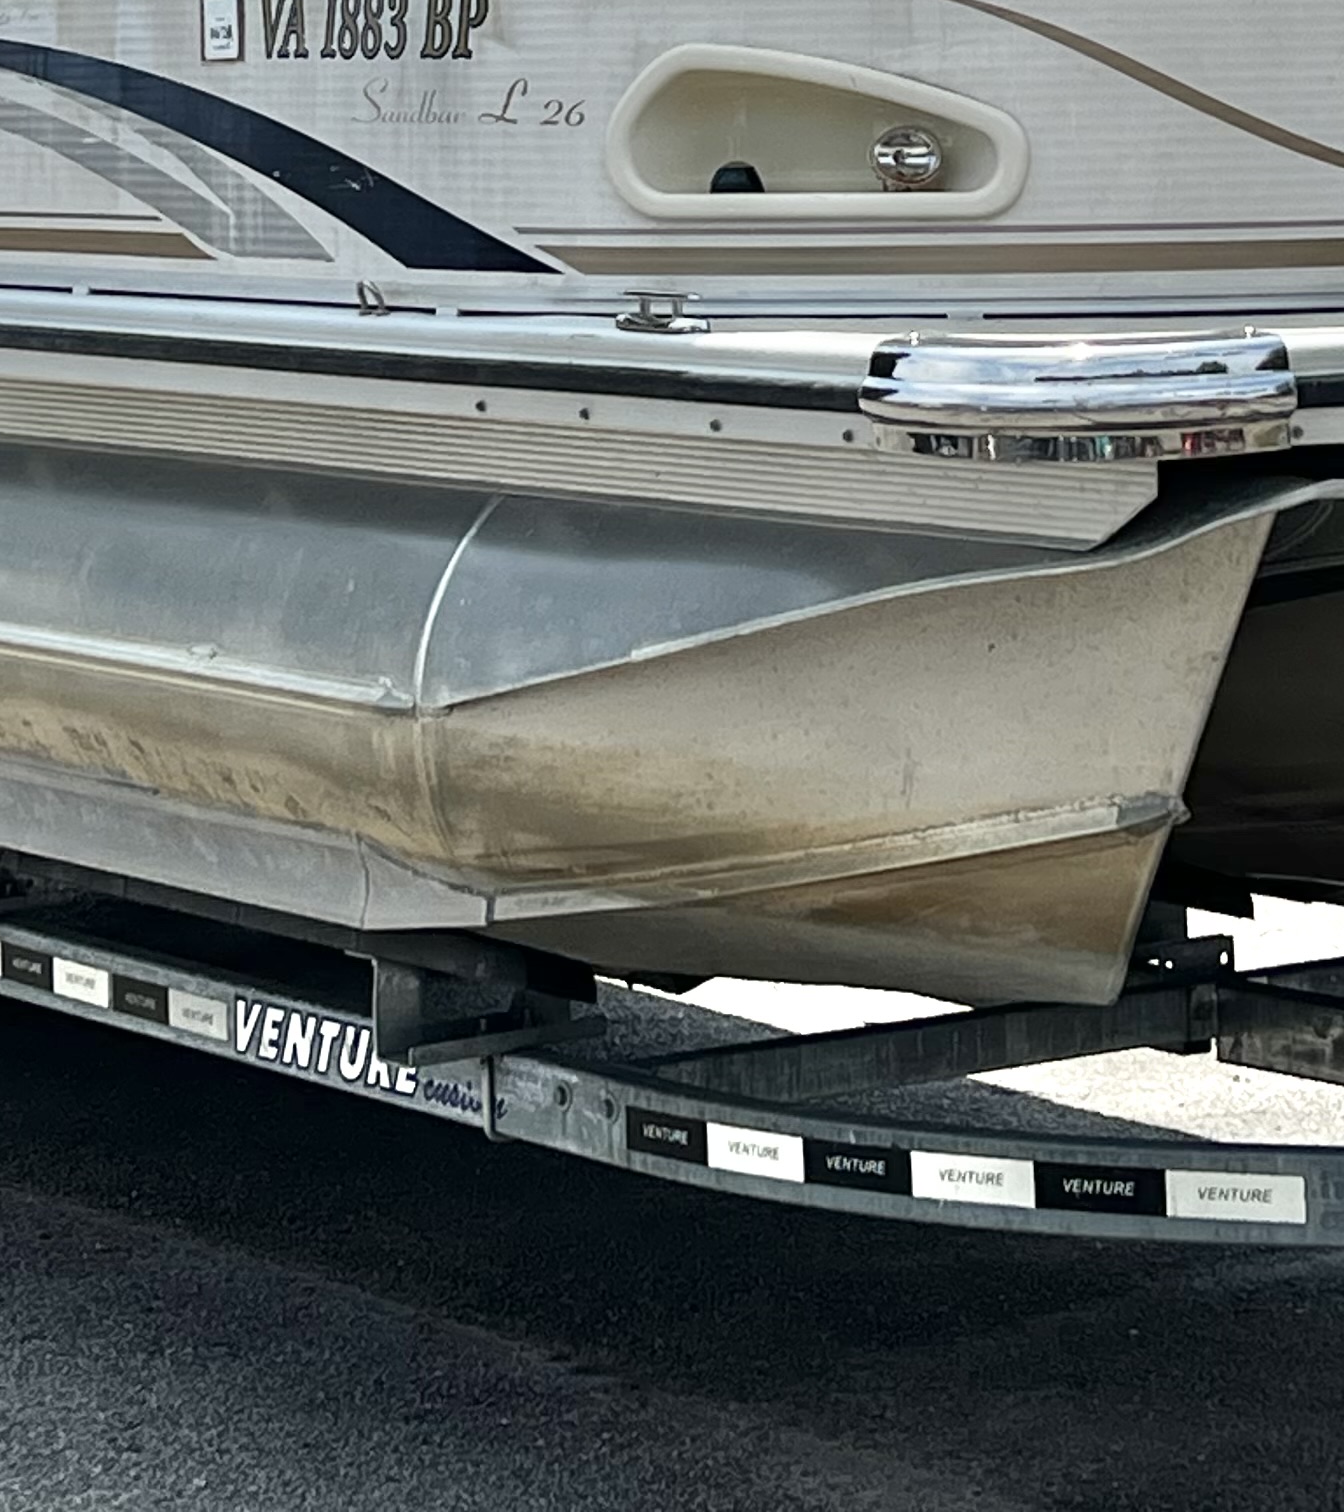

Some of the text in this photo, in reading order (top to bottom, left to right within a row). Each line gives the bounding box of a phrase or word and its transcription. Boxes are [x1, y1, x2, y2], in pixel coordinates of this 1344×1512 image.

[351, 77, 467, 124] Sandbar
[539, 99, 586, 127] 26
[641, 1122, 689, 1146] VENTURE
[728, 1140, 780, 1161] VENTURE
[825, 1155, 887, 1176] VENTURE
[939, 1168, 1004, 1187] VENTURE
[1062, 1177, 1135, 1197] VENTURE
[1197, 1187, 1274, 1204] VENTURE
